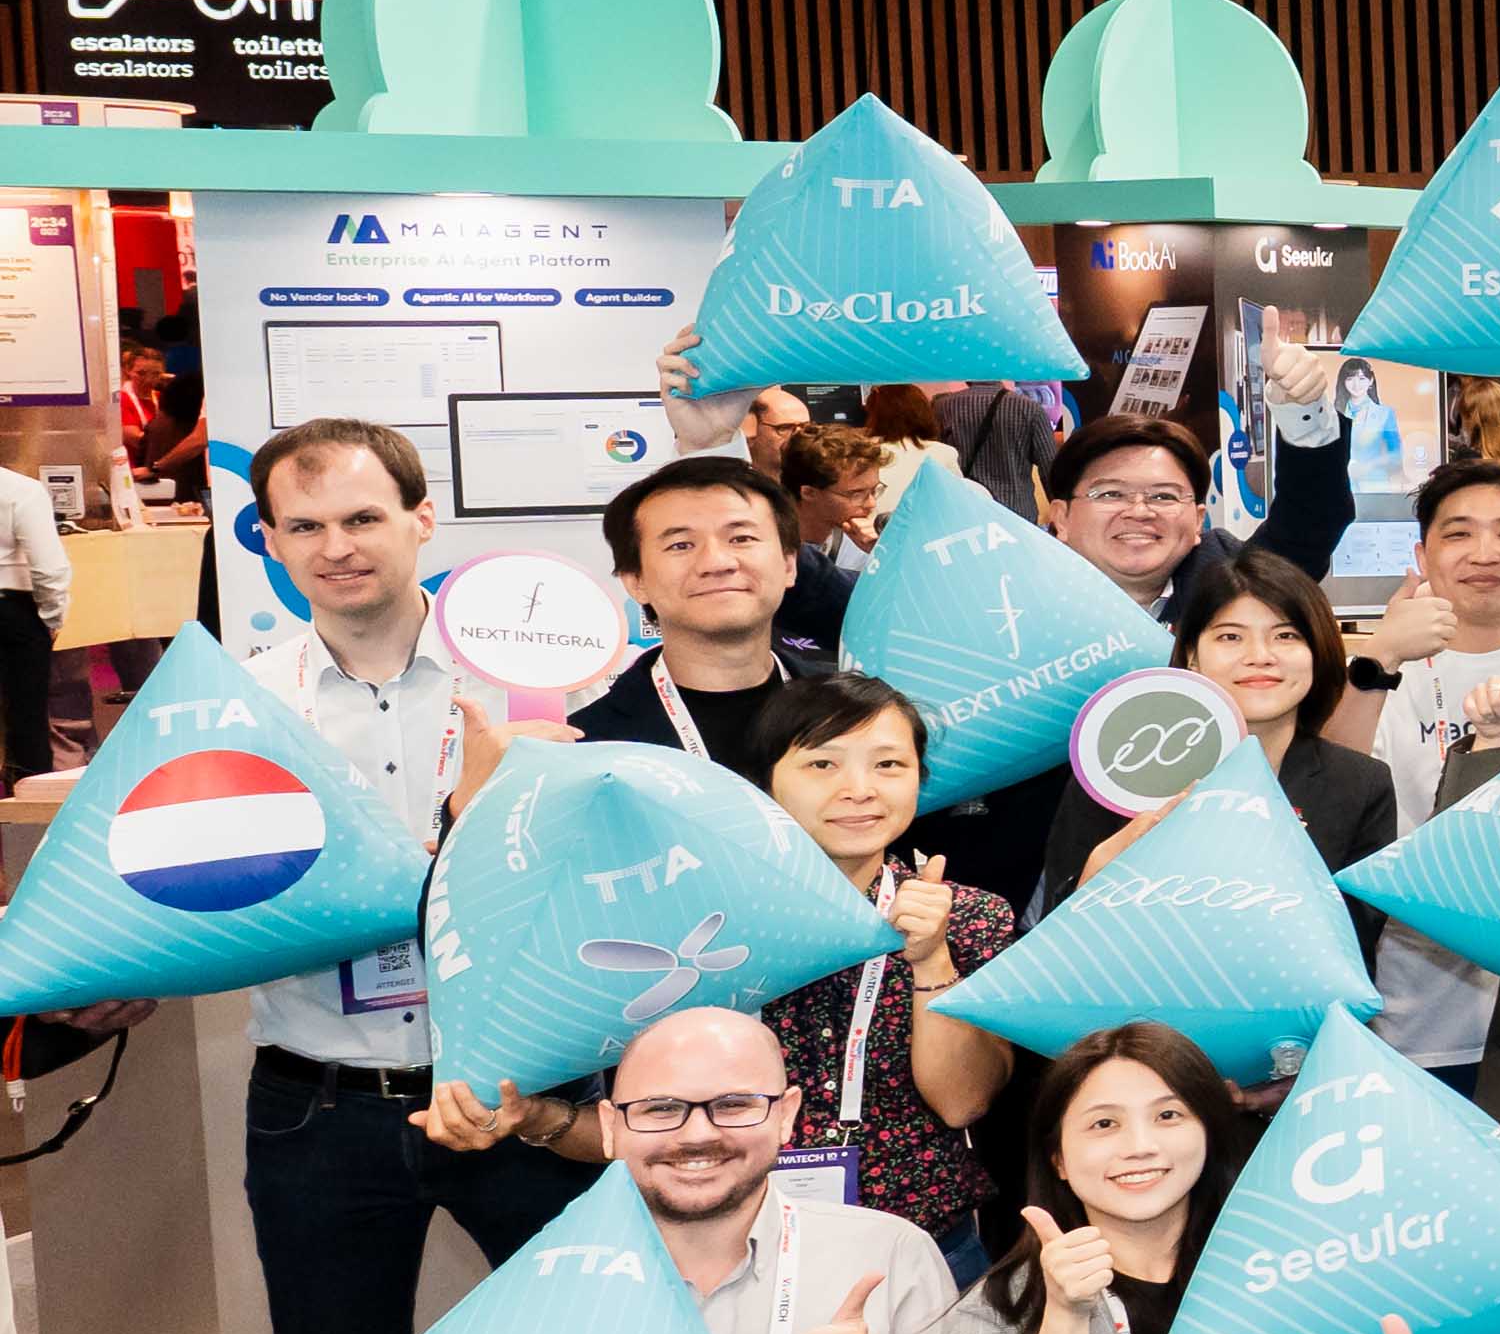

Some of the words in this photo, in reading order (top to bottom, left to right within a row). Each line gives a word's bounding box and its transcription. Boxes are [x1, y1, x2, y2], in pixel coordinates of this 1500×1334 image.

[70, 34, 195, 54] escalators
[233, 35, 324, 57] toilett
[74, 60, 194, 78] escalators
[832, 178, 923, 209] TTA
[401, 223, 609, 240] MAIAGENT
[327, 252, 429, 269] Enterprise
[528, 253, 610, 268] Platform
[1281, 245, 1333, 267] Seeular
[270, 292, 287, 303] No
[290, 292, 333, 303] Vendor
[413, 292, 459, 305] Agentic
[476, 292, 492, 303] for
[585, 292, 620, 305] Agent
[622, 292, 663, 303] Builder
[925, 521, 1020, 568] TTA
[460, 624, 510, 643] NEXT
[514, 630, 606, 651] INTEGRAL
[931, 686, 1006, 734] NEXT
[1007, 630, 1136, 697] INTEGRAL
[150, 699, 258, 737] TTA
[1190, 788, 1271, 820] TTA
[583, 844, 702, 904] TTA
[1294, 1071, 1396, 1117] TTA
[533, 1245, 646, 1283] TTA
[1243, 1208, 1451, 1294] Seeular
